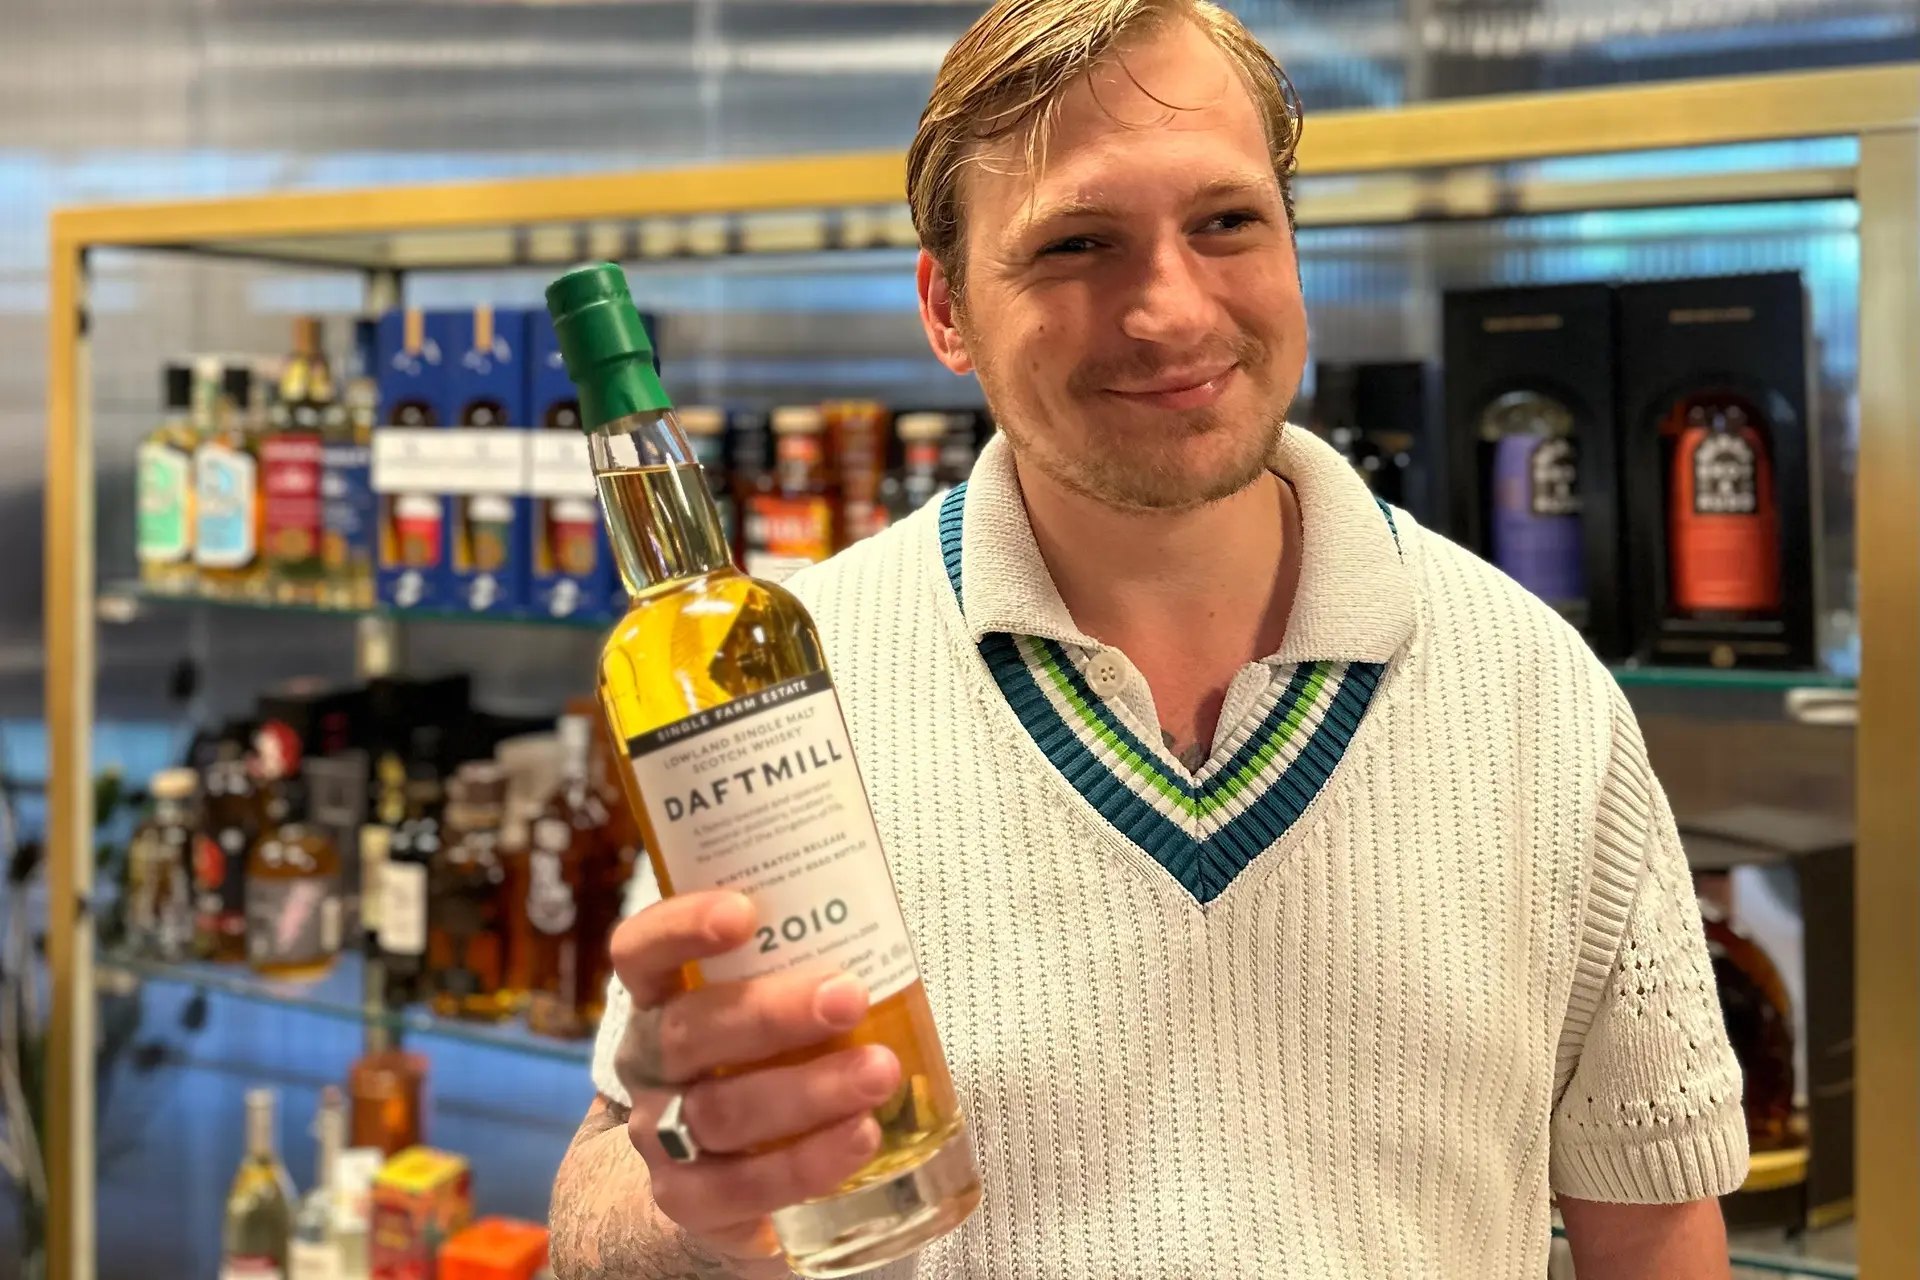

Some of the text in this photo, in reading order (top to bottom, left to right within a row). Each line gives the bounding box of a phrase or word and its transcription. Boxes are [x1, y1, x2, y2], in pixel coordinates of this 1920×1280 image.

[656, 680, 808, 742] SINGLE FARM ESTATE
[663, 706, 816, 770] LOWLAND SINGLE MALT
[692, 726, 802, 774] SCOTCH WHISKY
[664, 738, 843, 822] DAFTMILL
[715, 832, 847, 888] WINTER BATCH RELEASE
[755, 897, 849, 953] 2010
